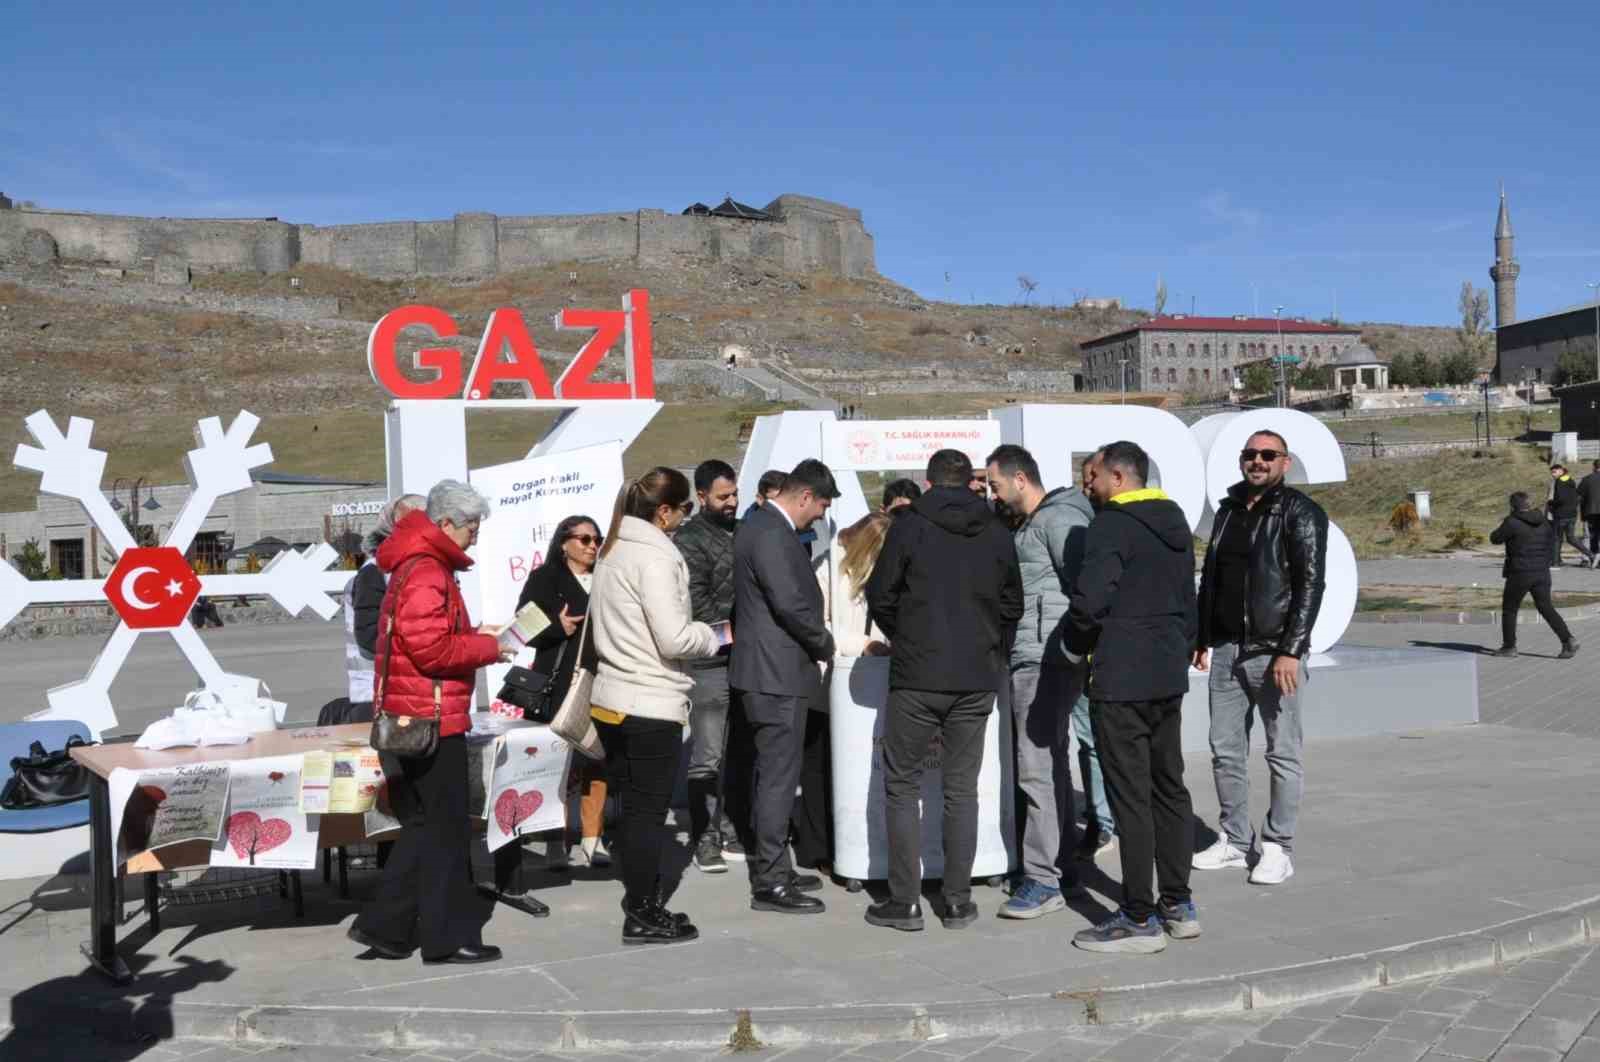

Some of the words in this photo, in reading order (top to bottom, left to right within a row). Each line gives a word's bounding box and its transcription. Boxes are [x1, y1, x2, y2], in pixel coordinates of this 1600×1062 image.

[901, 428, 933, 440] SAĞLIK
[933, 428, 981, 440] BAKANLIĞI
[511, 477, 547, 493] Organ
[499, 492, 533, 507] Hayat
[332, 502, 386, 516] KOCATE
